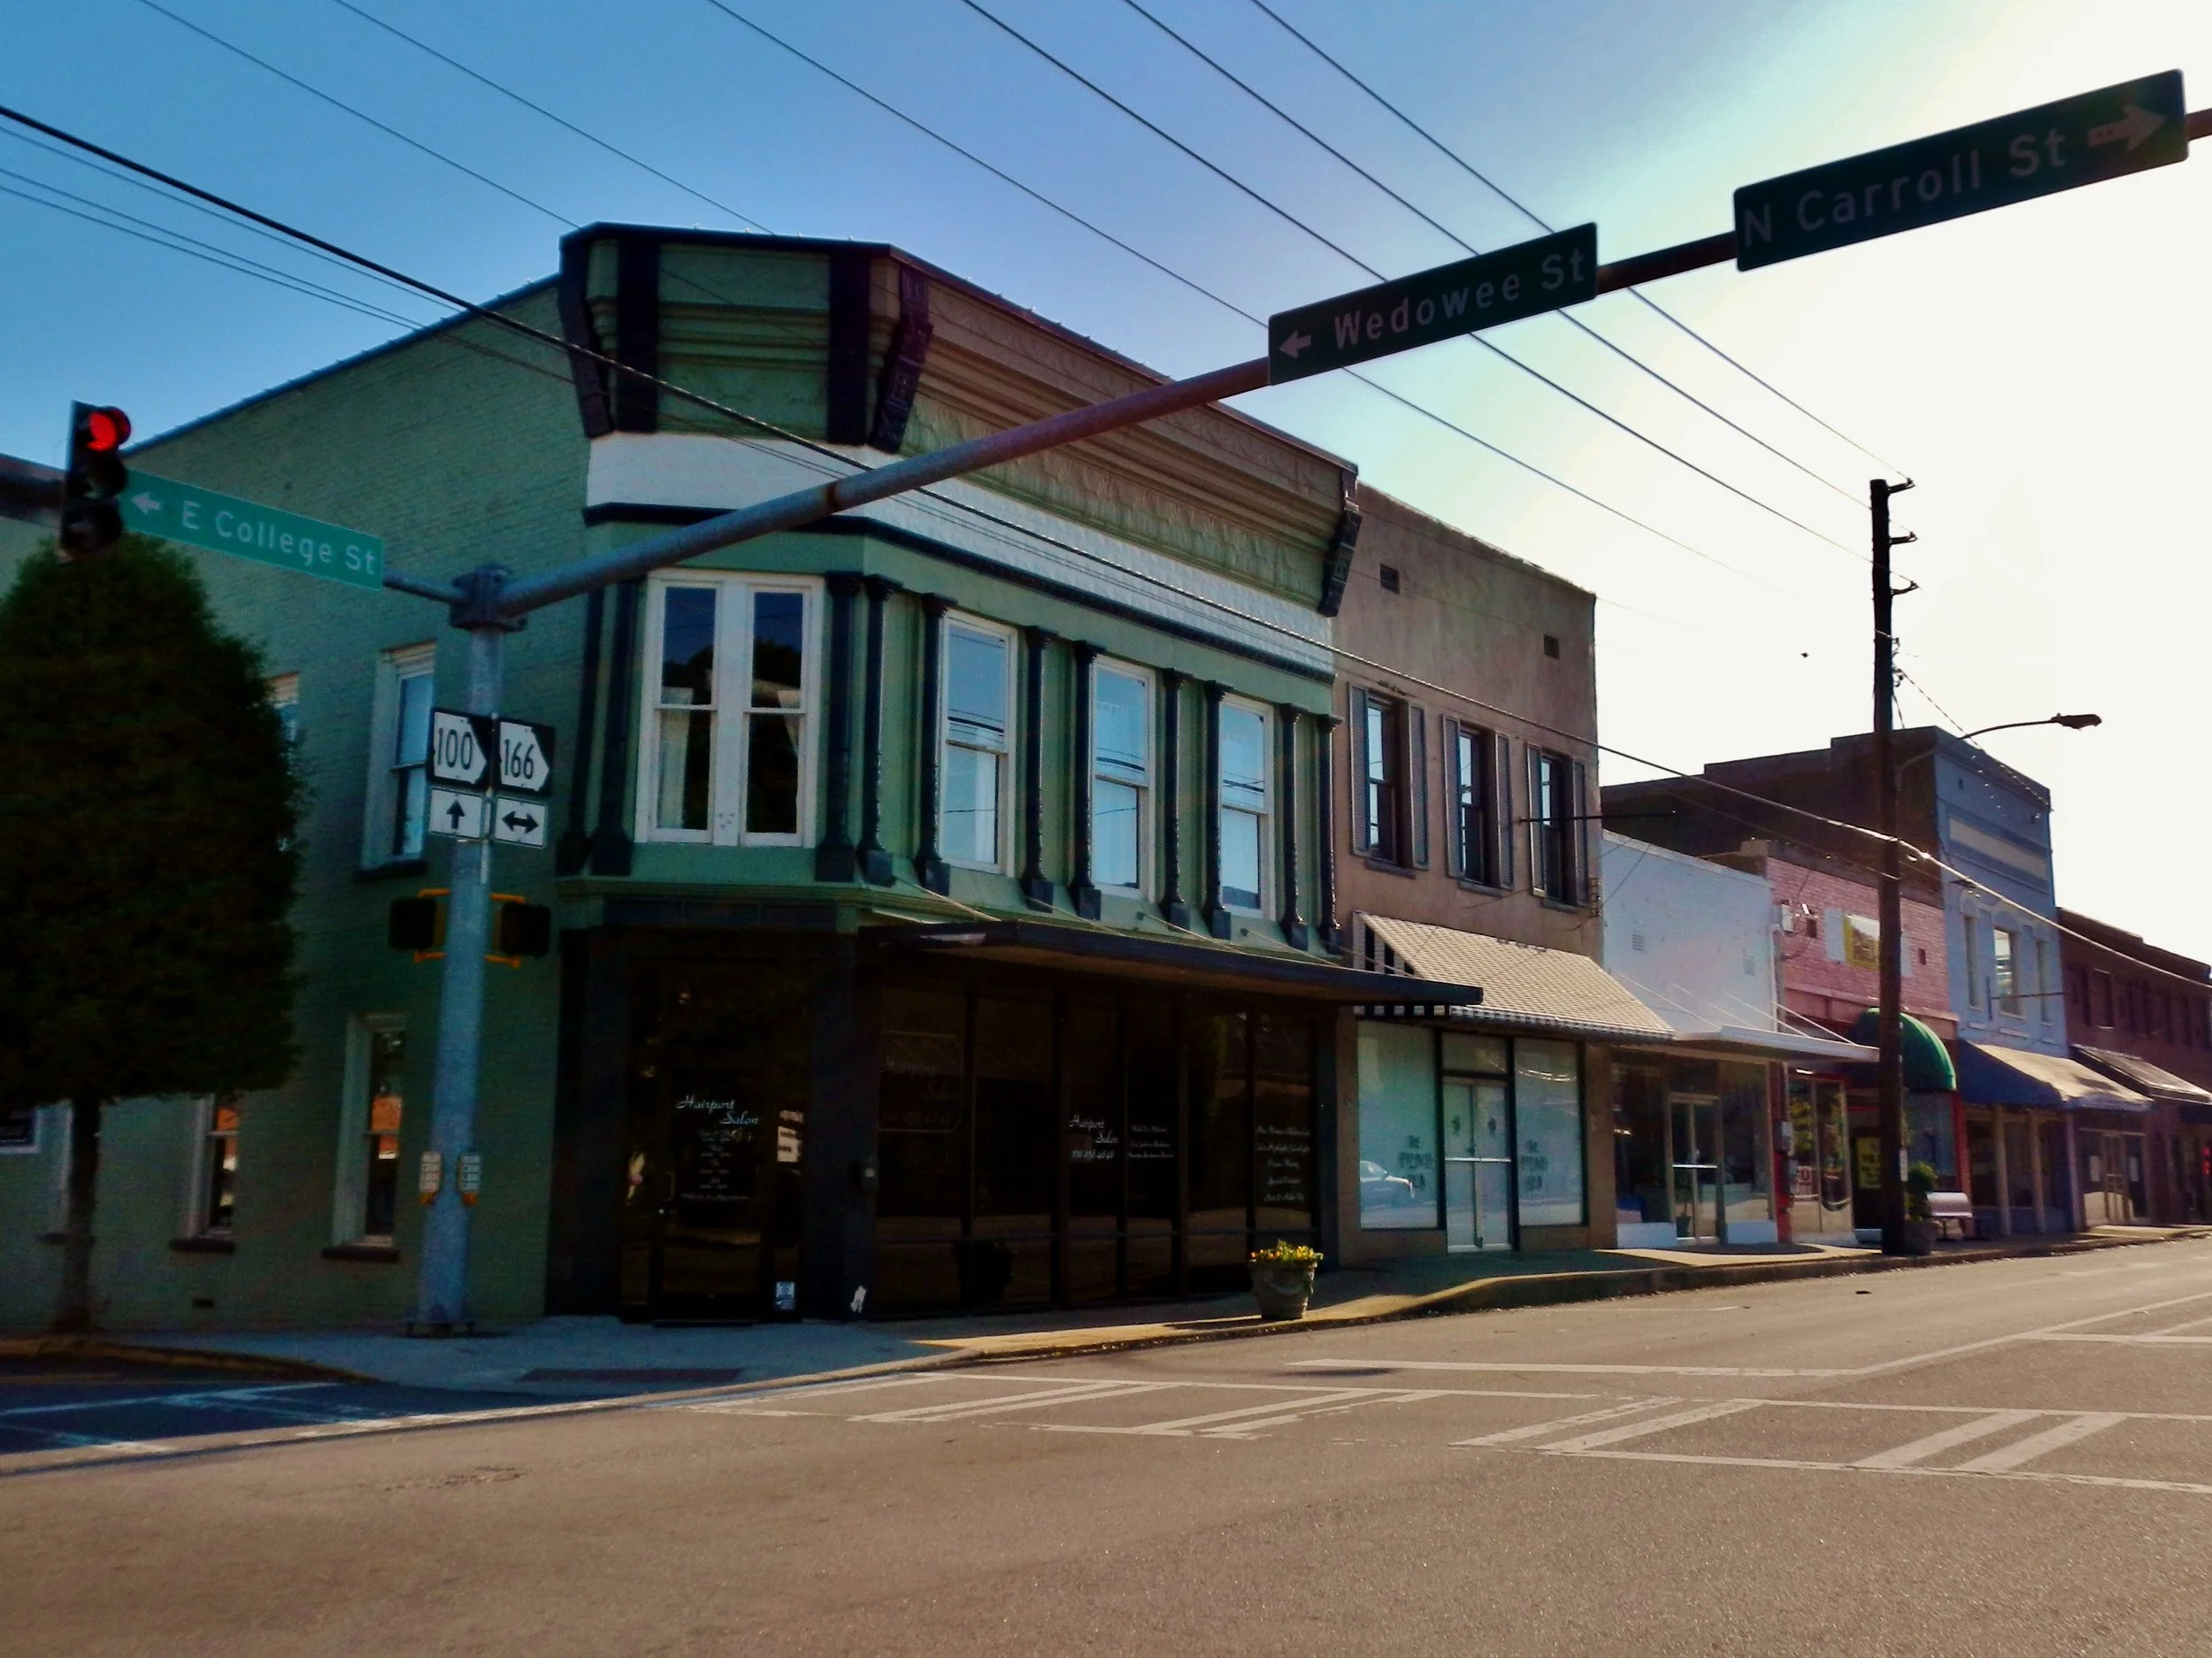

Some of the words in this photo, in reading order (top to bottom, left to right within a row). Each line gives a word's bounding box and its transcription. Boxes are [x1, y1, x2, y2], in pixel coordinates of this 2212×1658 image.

[1743, 204, 1770, 248] N
[1796, 149, 1980, 232] Carroll
[2009, 127, 2066, 177] St
[1334, 273, 1520, 349] Wedowee
[1541, 248, 1586, 290] St
[182, 500, 202, 530] E
[215, 510, 333, 566] College
[344, 544, 375, 575] St
[436, 727, 473, 770] 100
[503, 738, 534, 779] 166
[675, 1094, 735, 1115] Hairport
[719, 1109, 759, 1125] Salon
